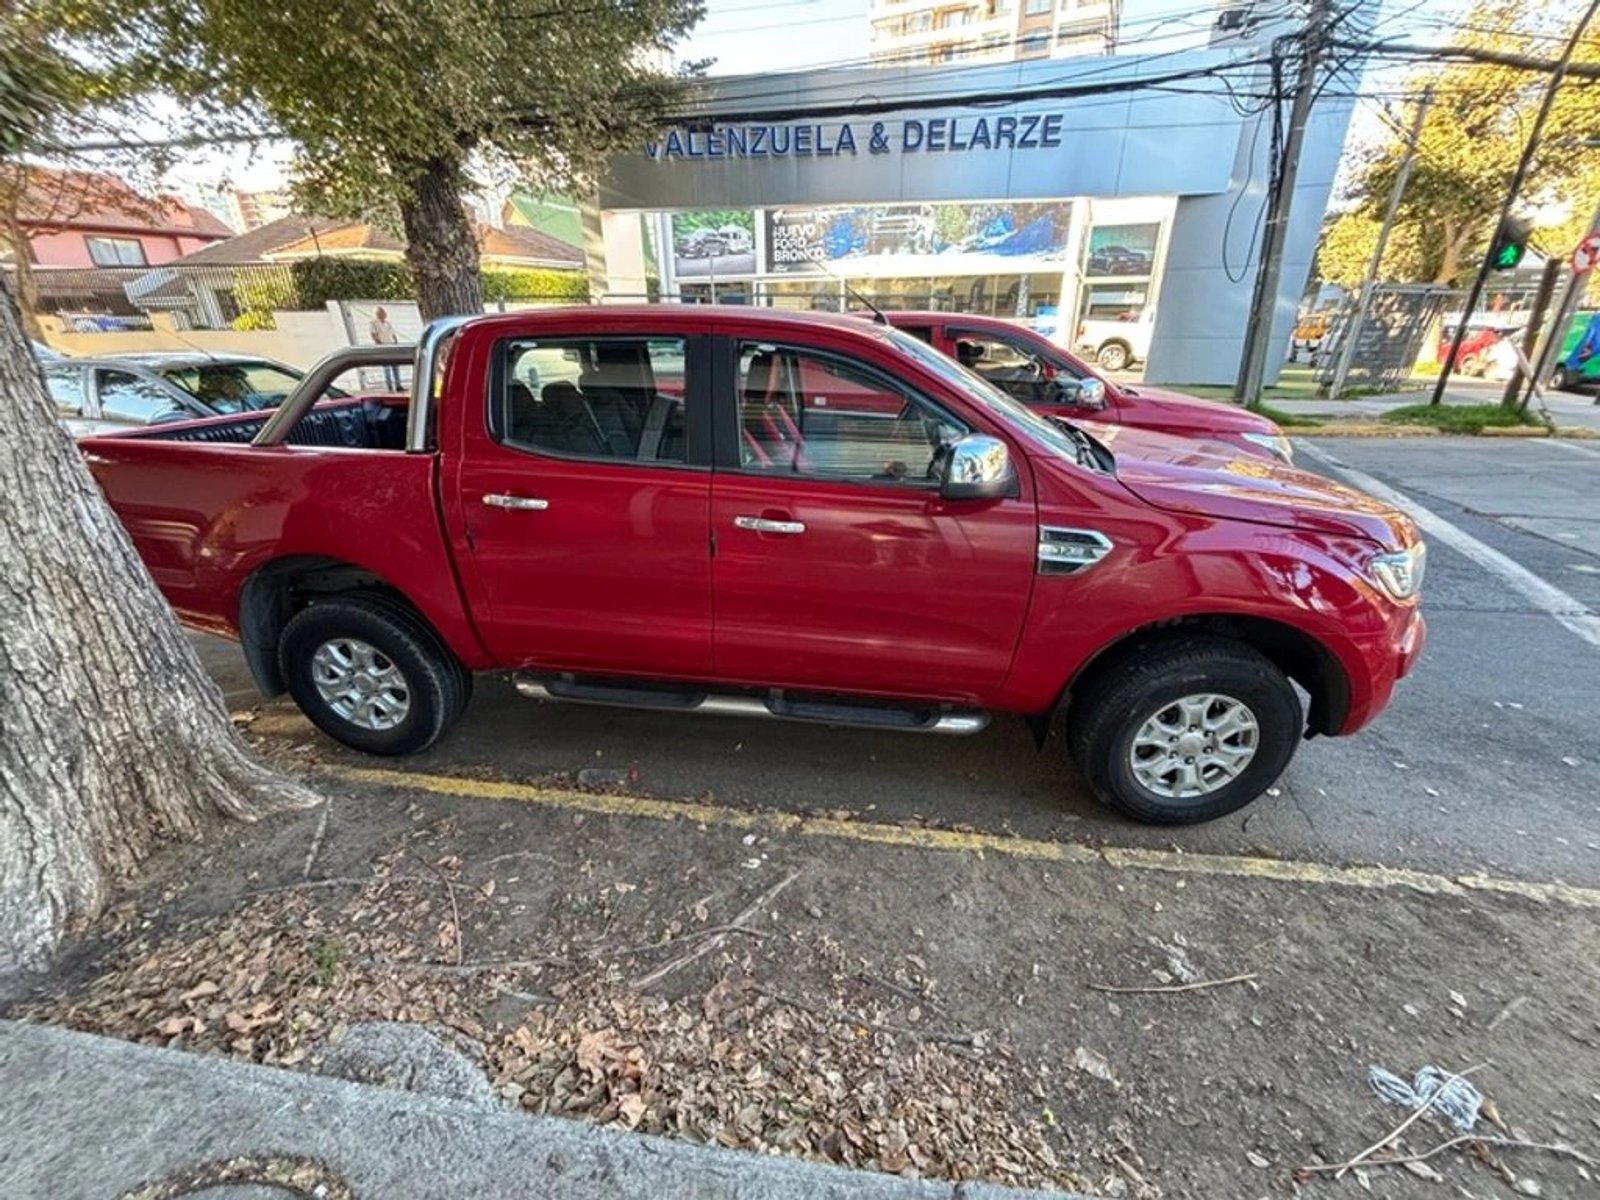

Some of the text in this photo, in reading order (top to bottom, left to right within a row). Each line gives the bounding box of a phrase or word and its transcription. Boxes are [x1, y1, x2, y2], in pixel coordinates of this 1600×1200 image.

[868, 121, 890, 154] &
[901, 114, 1064, 153] DELARZE
[773, 236, 807, 250] FORD
[773, 247, 824, 262] BRONCO
